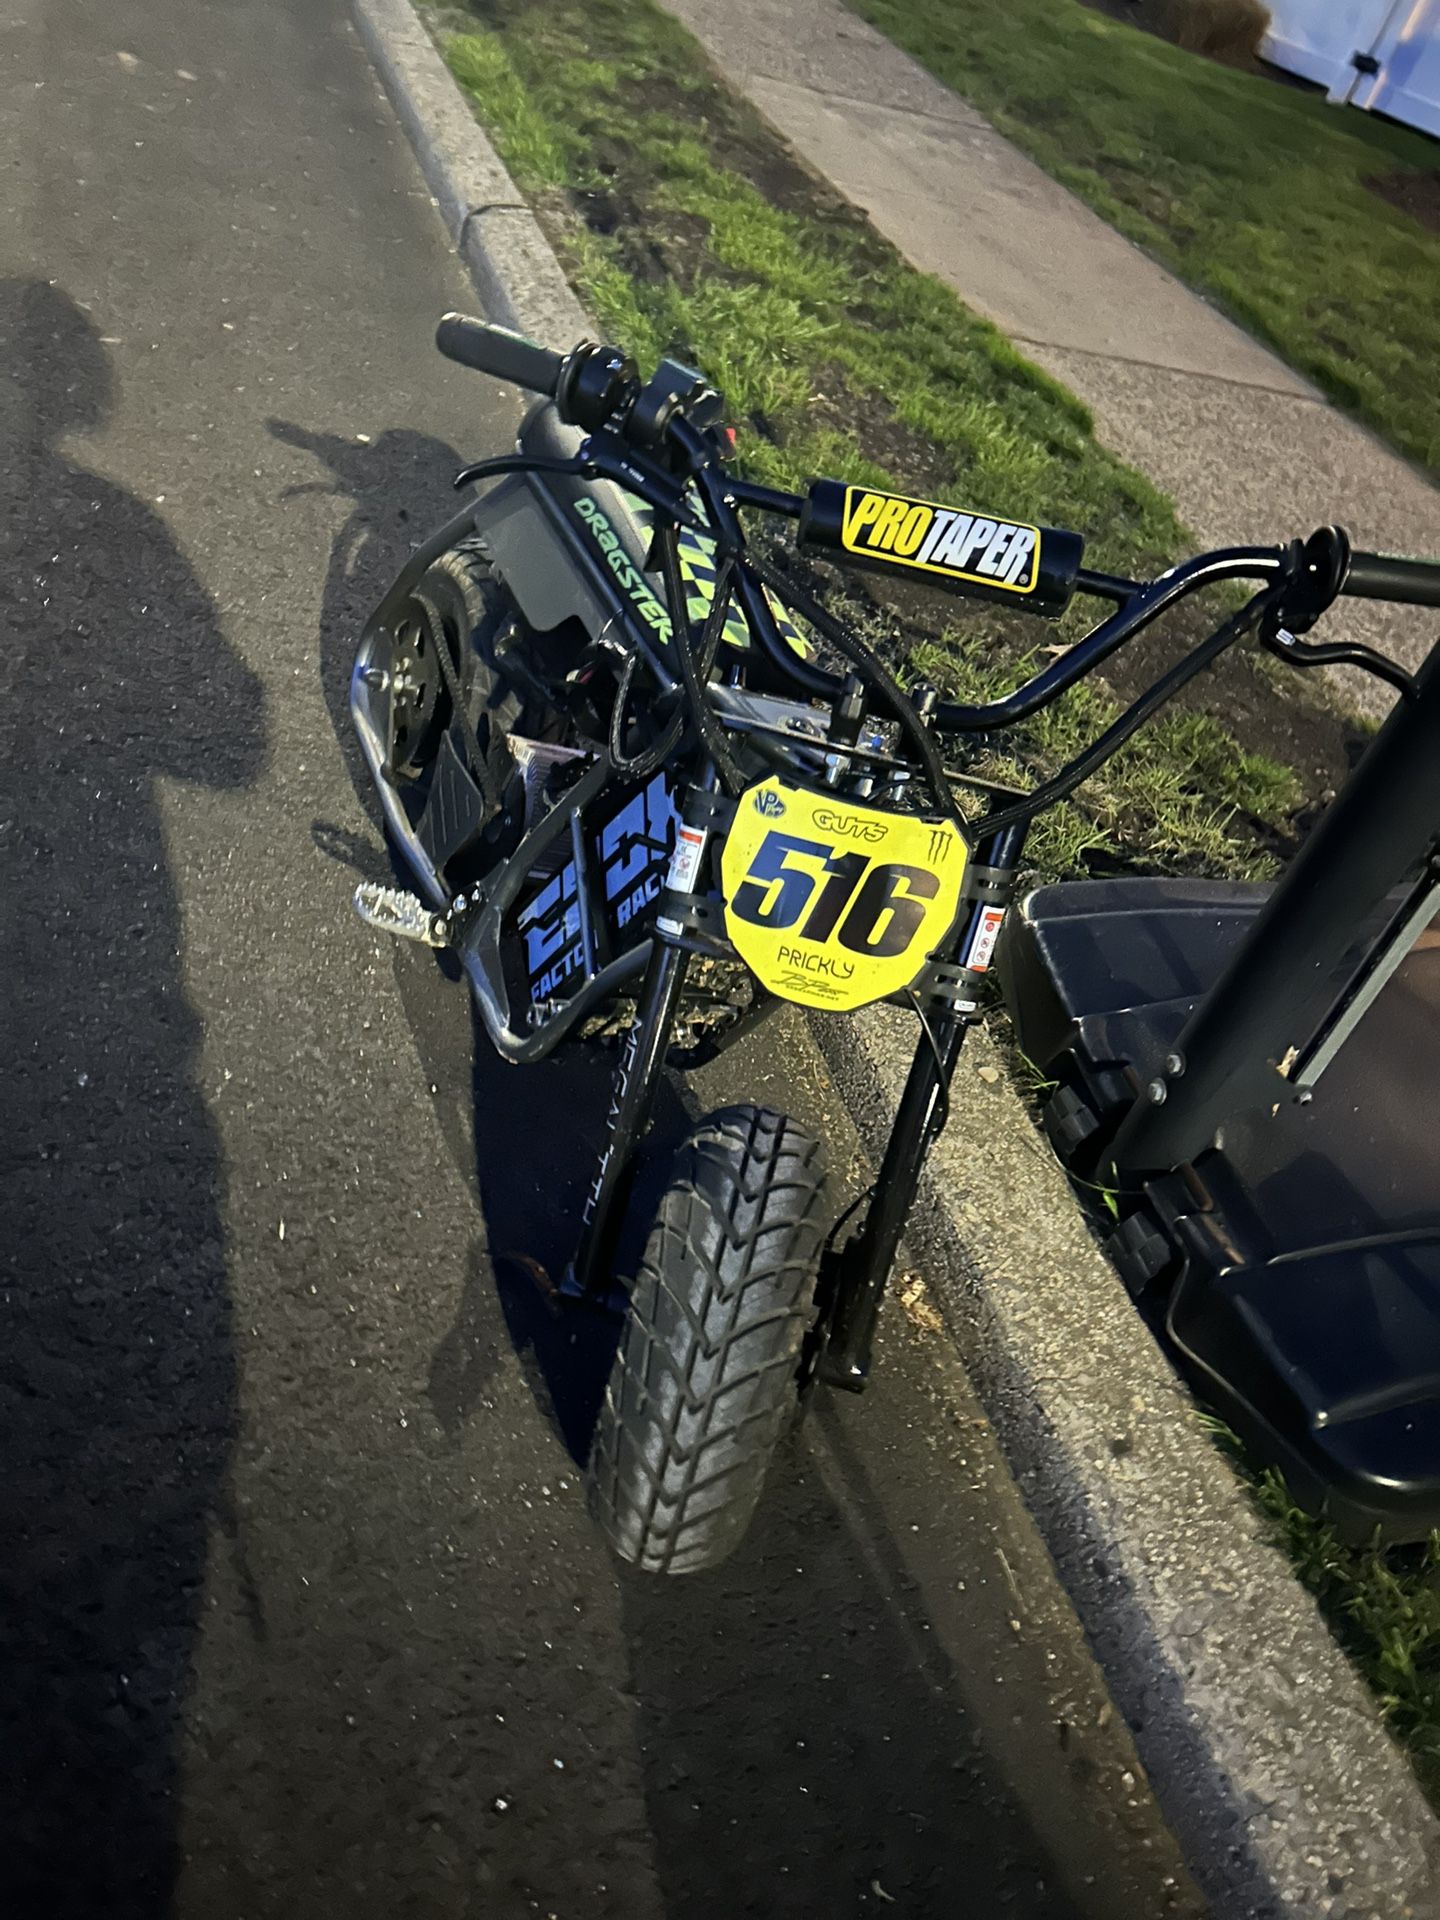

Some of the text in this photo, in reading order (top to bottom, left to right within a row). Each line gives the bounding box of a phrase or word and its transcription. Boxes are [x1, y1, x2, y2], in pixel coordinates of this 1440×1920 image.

[811, 808, 888, 842] GUTS
[730, 830, 941, 958] 516
[530, 942, 584, 1004] FACTO
[777, 945, 855, 980] PRICKLY
